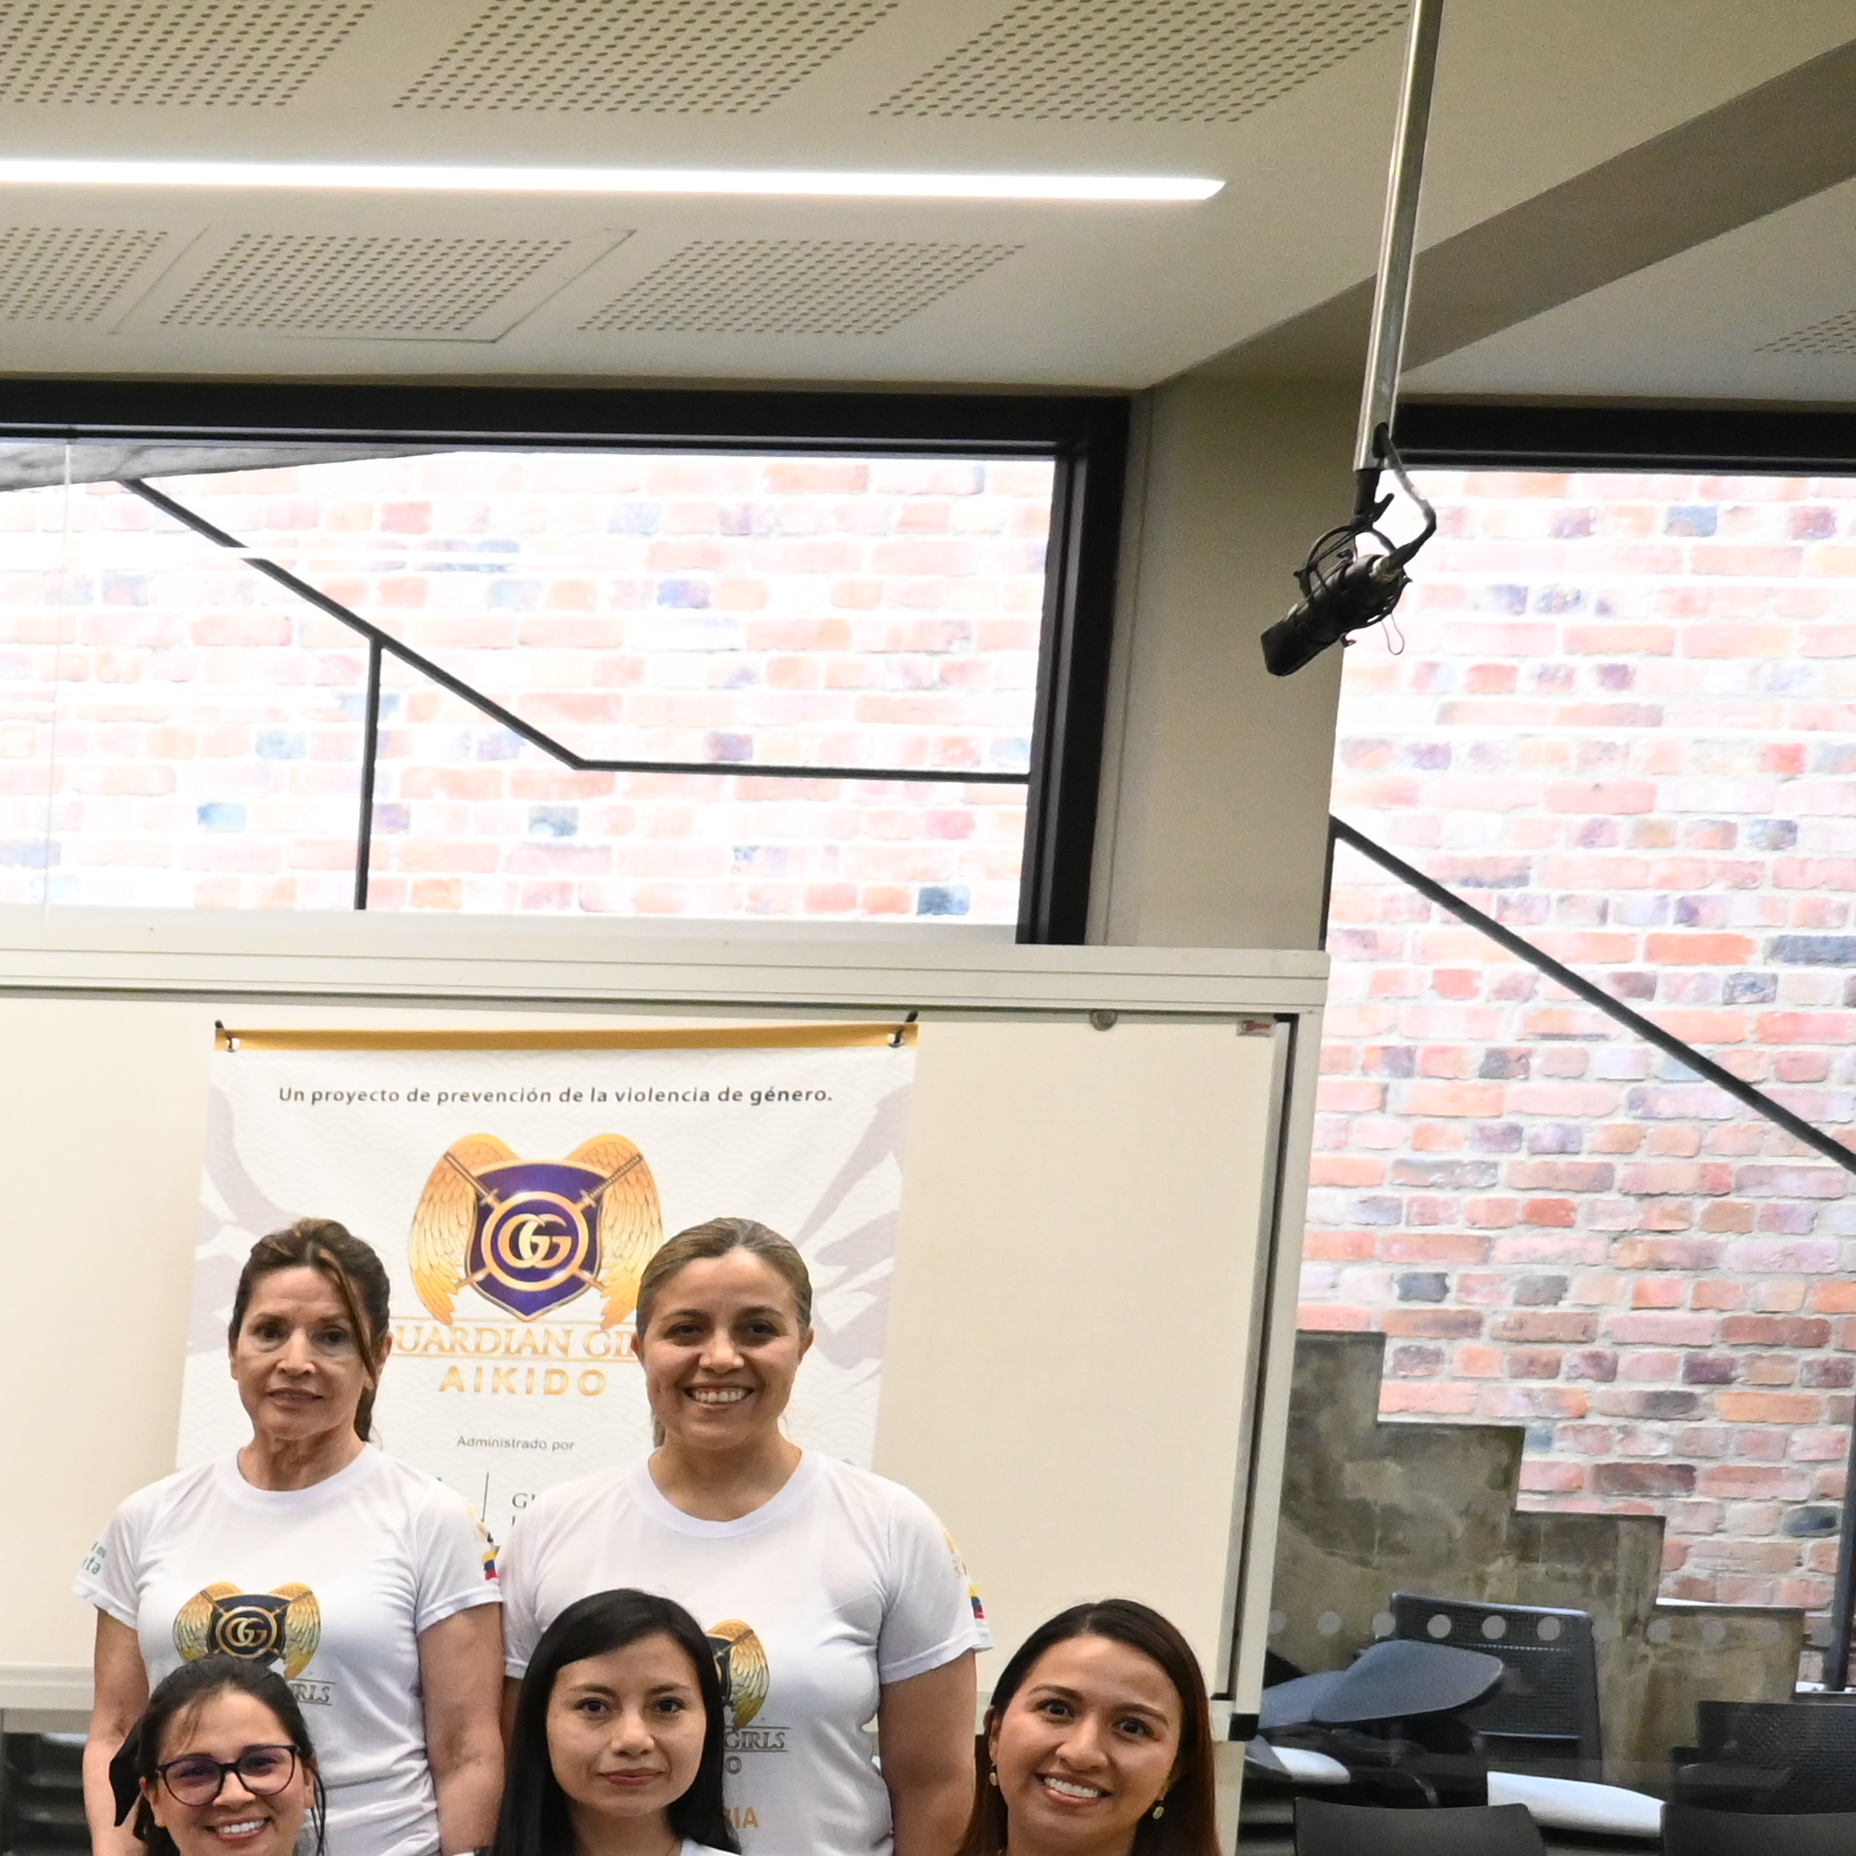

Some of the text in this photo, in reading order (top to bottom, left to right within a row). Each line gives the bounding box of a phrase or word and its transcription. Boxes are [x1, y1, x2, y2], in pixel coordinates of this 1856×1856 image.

[279, 1085, 834, 1106] Un proyecto de prevención de la violencia de género.
[395, 1324, 573, 1357] UARDIAN
[438, 1364, 607, 1397] AIKIDO
[456, 1435, 575, 1453] Administrado por
